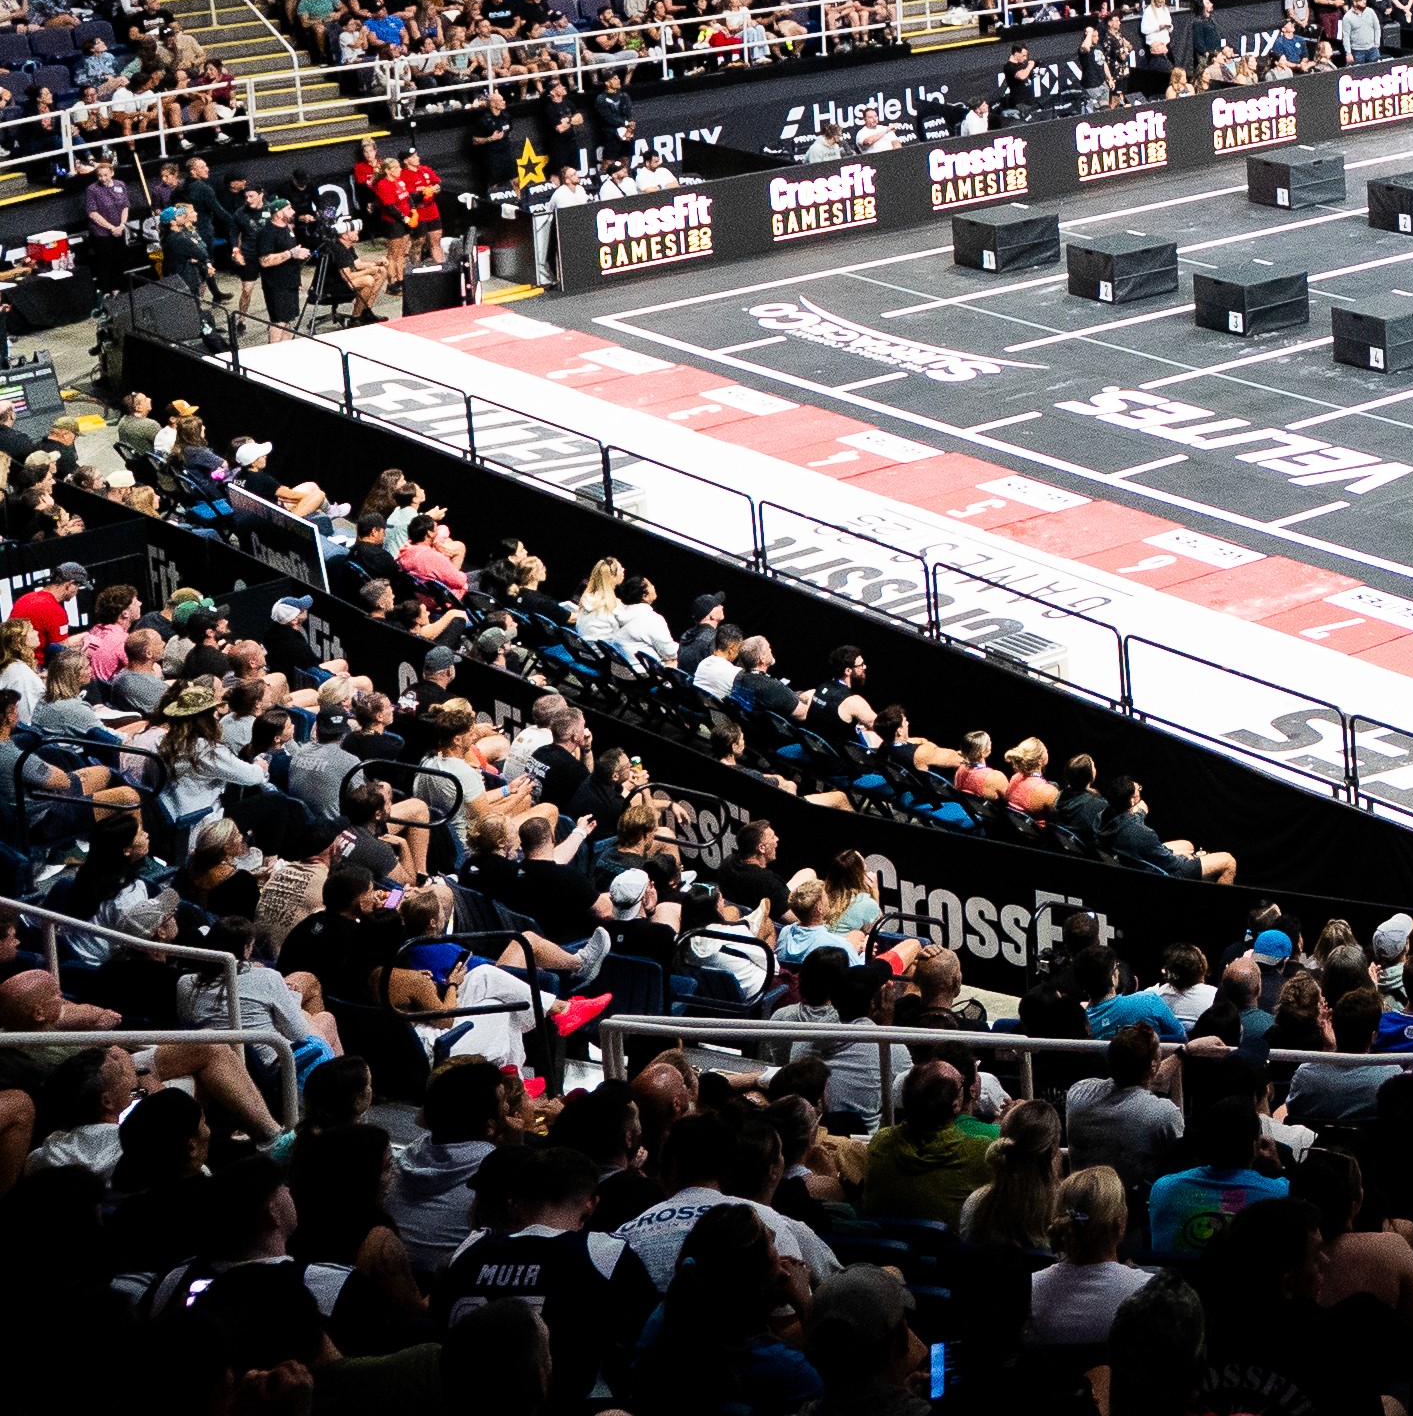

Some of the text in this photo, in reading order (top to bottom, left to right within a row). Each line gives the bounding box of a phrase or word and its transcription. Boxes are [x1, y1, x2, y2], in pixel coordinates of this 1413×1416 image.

[813, 97, 901, 132] Hustle
[1211, 86, 1297, 129] CrossFit
[1075, 109, 1167, 155] CrossFit
[928, 134, 1028, 183] CrossFit
[1078, 149, 1141, 179] GAMES
[769, 164, 877, 212] CrossFit
[931, 175, 998, 207] GAMES
[596, 192, 714, 242] CrossFit
[773, 206, 846, 242] GAMES
[599, 233, 681, 268] GAMES
[476, 1264, 541, 1288] MUIR
